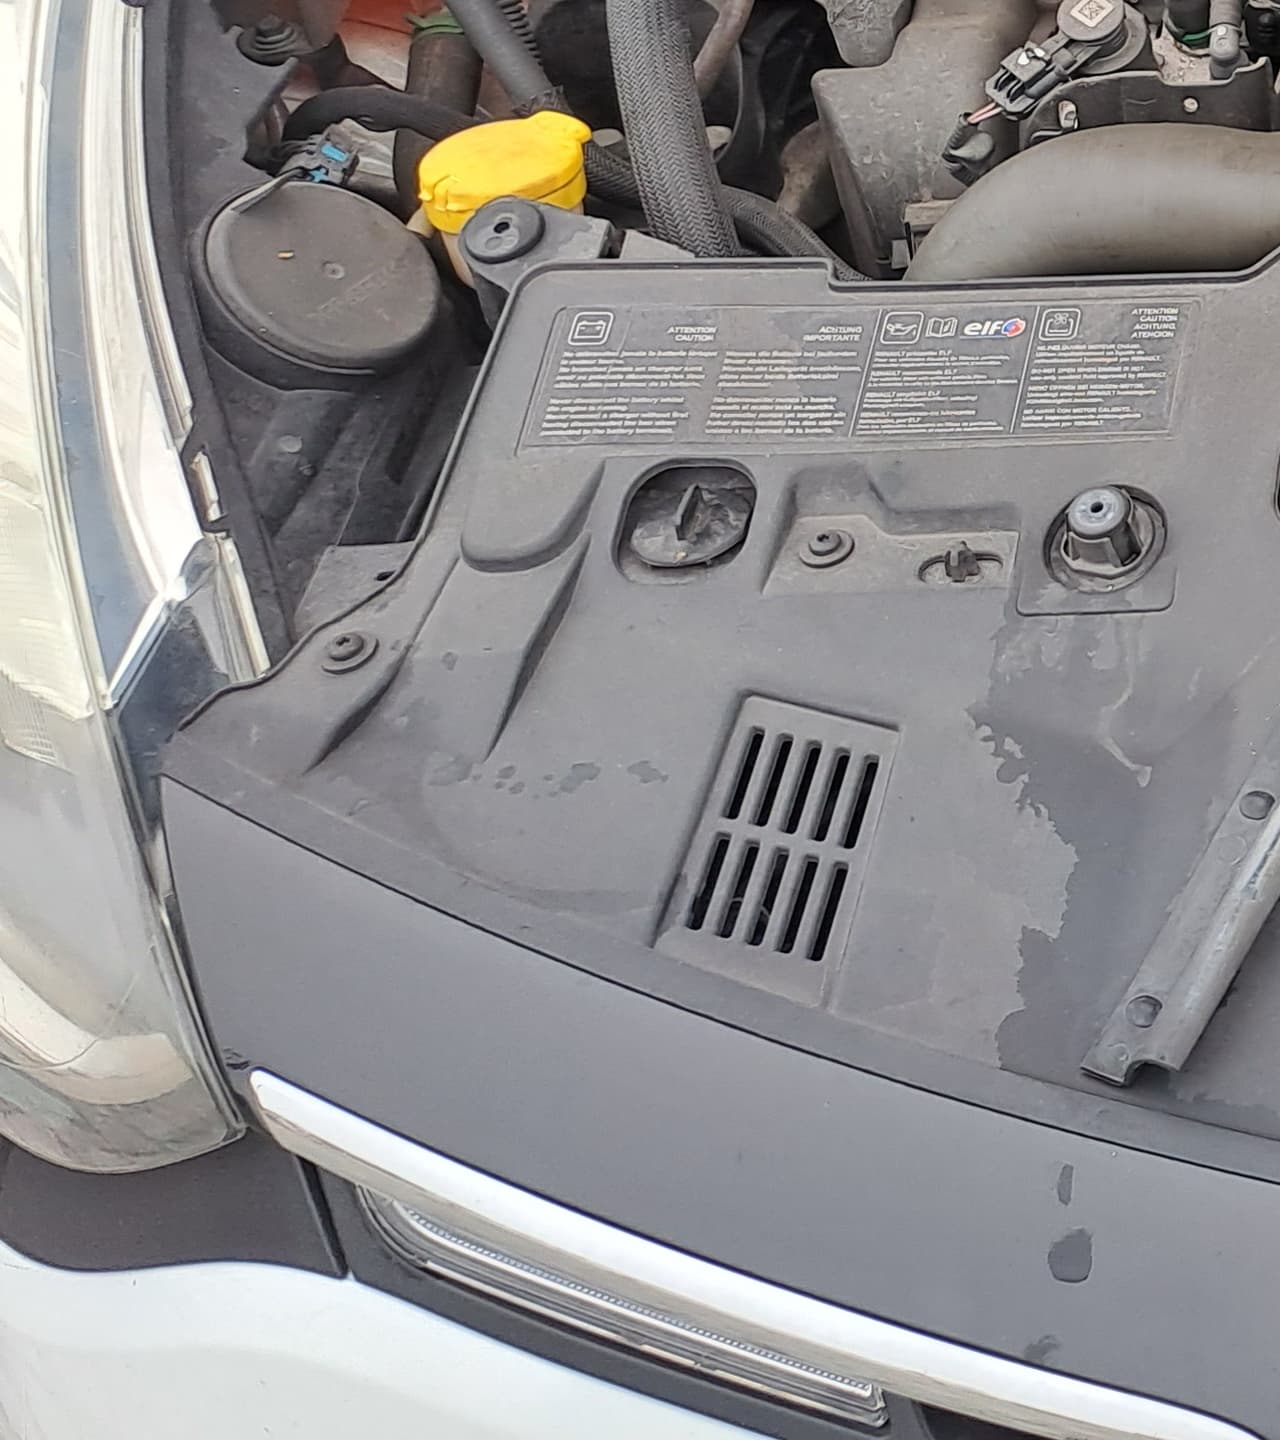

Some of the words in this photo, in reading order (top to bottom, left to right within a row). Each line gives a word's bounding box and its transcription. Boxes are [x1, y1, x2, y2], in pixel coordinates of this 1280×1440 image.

[1131, 307, 1179, 315] ATTENTION
[667, 326, 717, 334] ATTENTION
[818, 326, 863, 334] ACHTUNG
[963, 319, 1004, 336] elf
[674, 334, 714, 342] CAUTION
